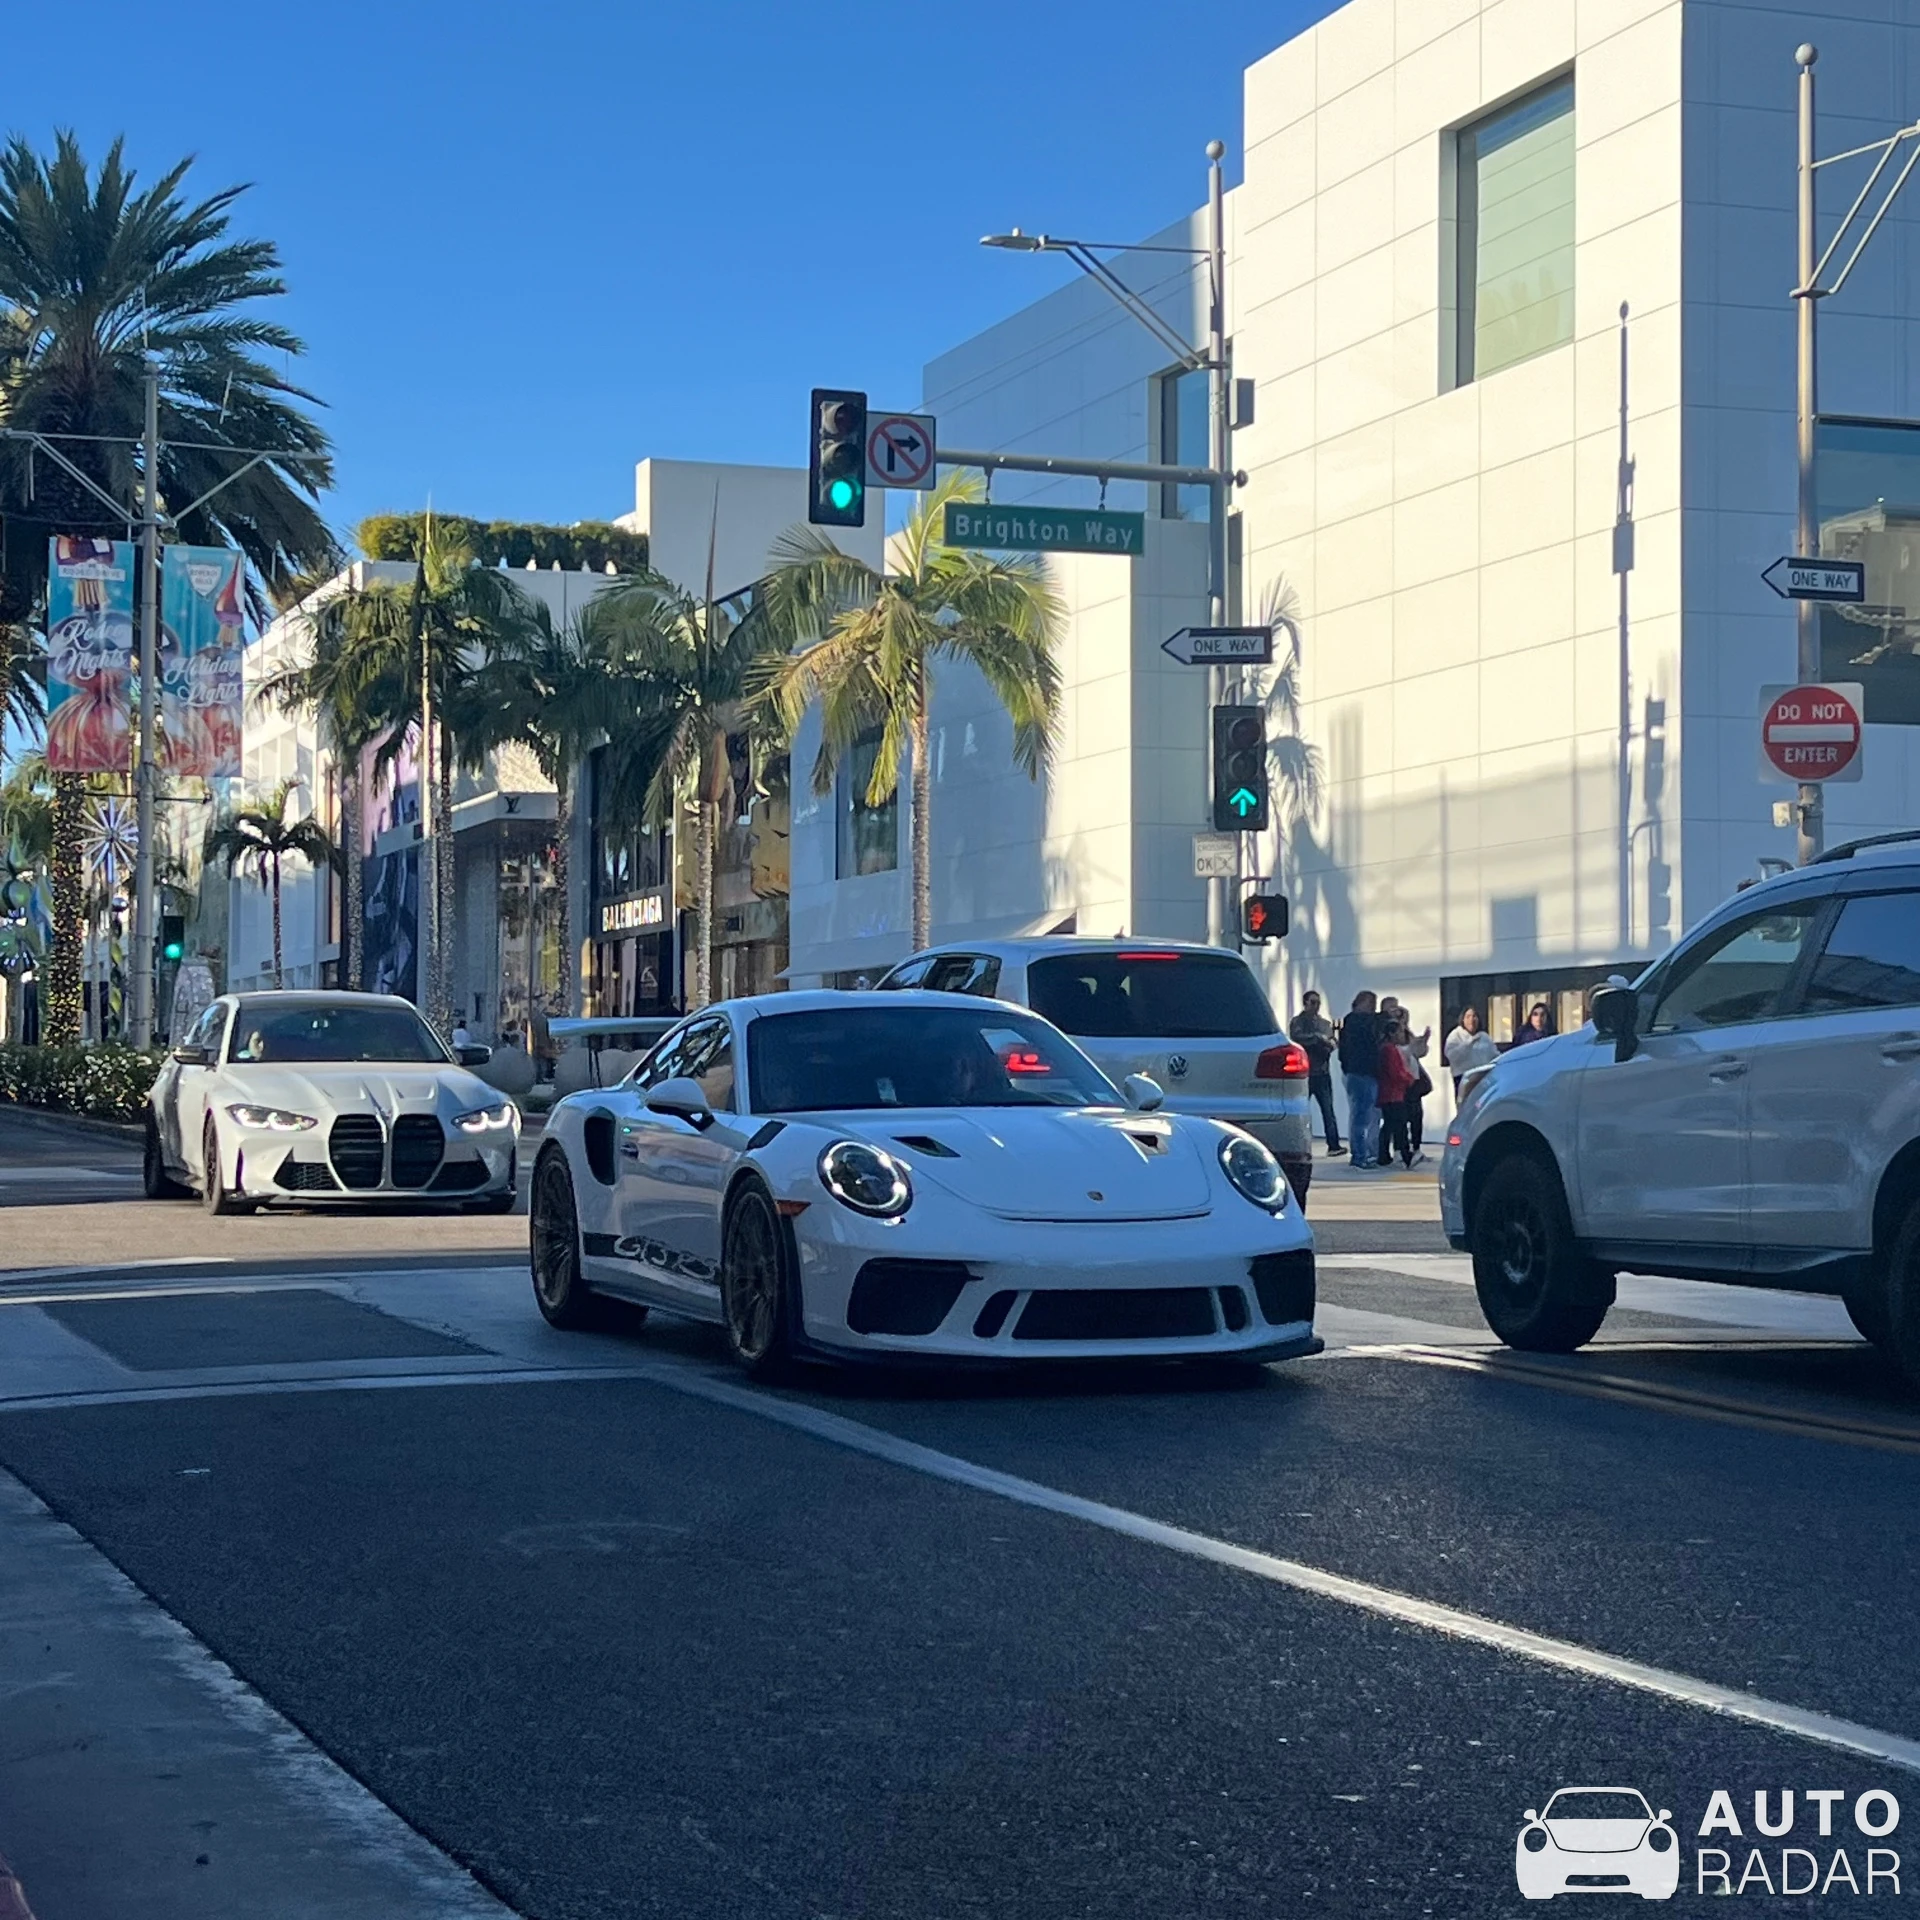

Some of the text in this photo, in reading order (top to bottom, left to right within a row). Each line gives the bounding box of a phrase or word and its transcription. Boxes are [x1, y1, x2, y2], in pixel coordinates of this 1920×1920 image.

[954, 513, 1133, 550] Brighton Way
[1791, 570, 1852, 589] ONE WAY
[1193, 638, 1258, 654] ONE WAY
[54, 647, 126, 680] Nights
[164, 657, 239, 685] Holiday
[179, 682, 238, 706] Lights
[1777, 703, 1846, 720] DO NOT
[1784, 746, 1838, 763] ENTER
[1196, 857, 1214, 872] OK
[602, 895, 663, 932] BALENCIAGA
